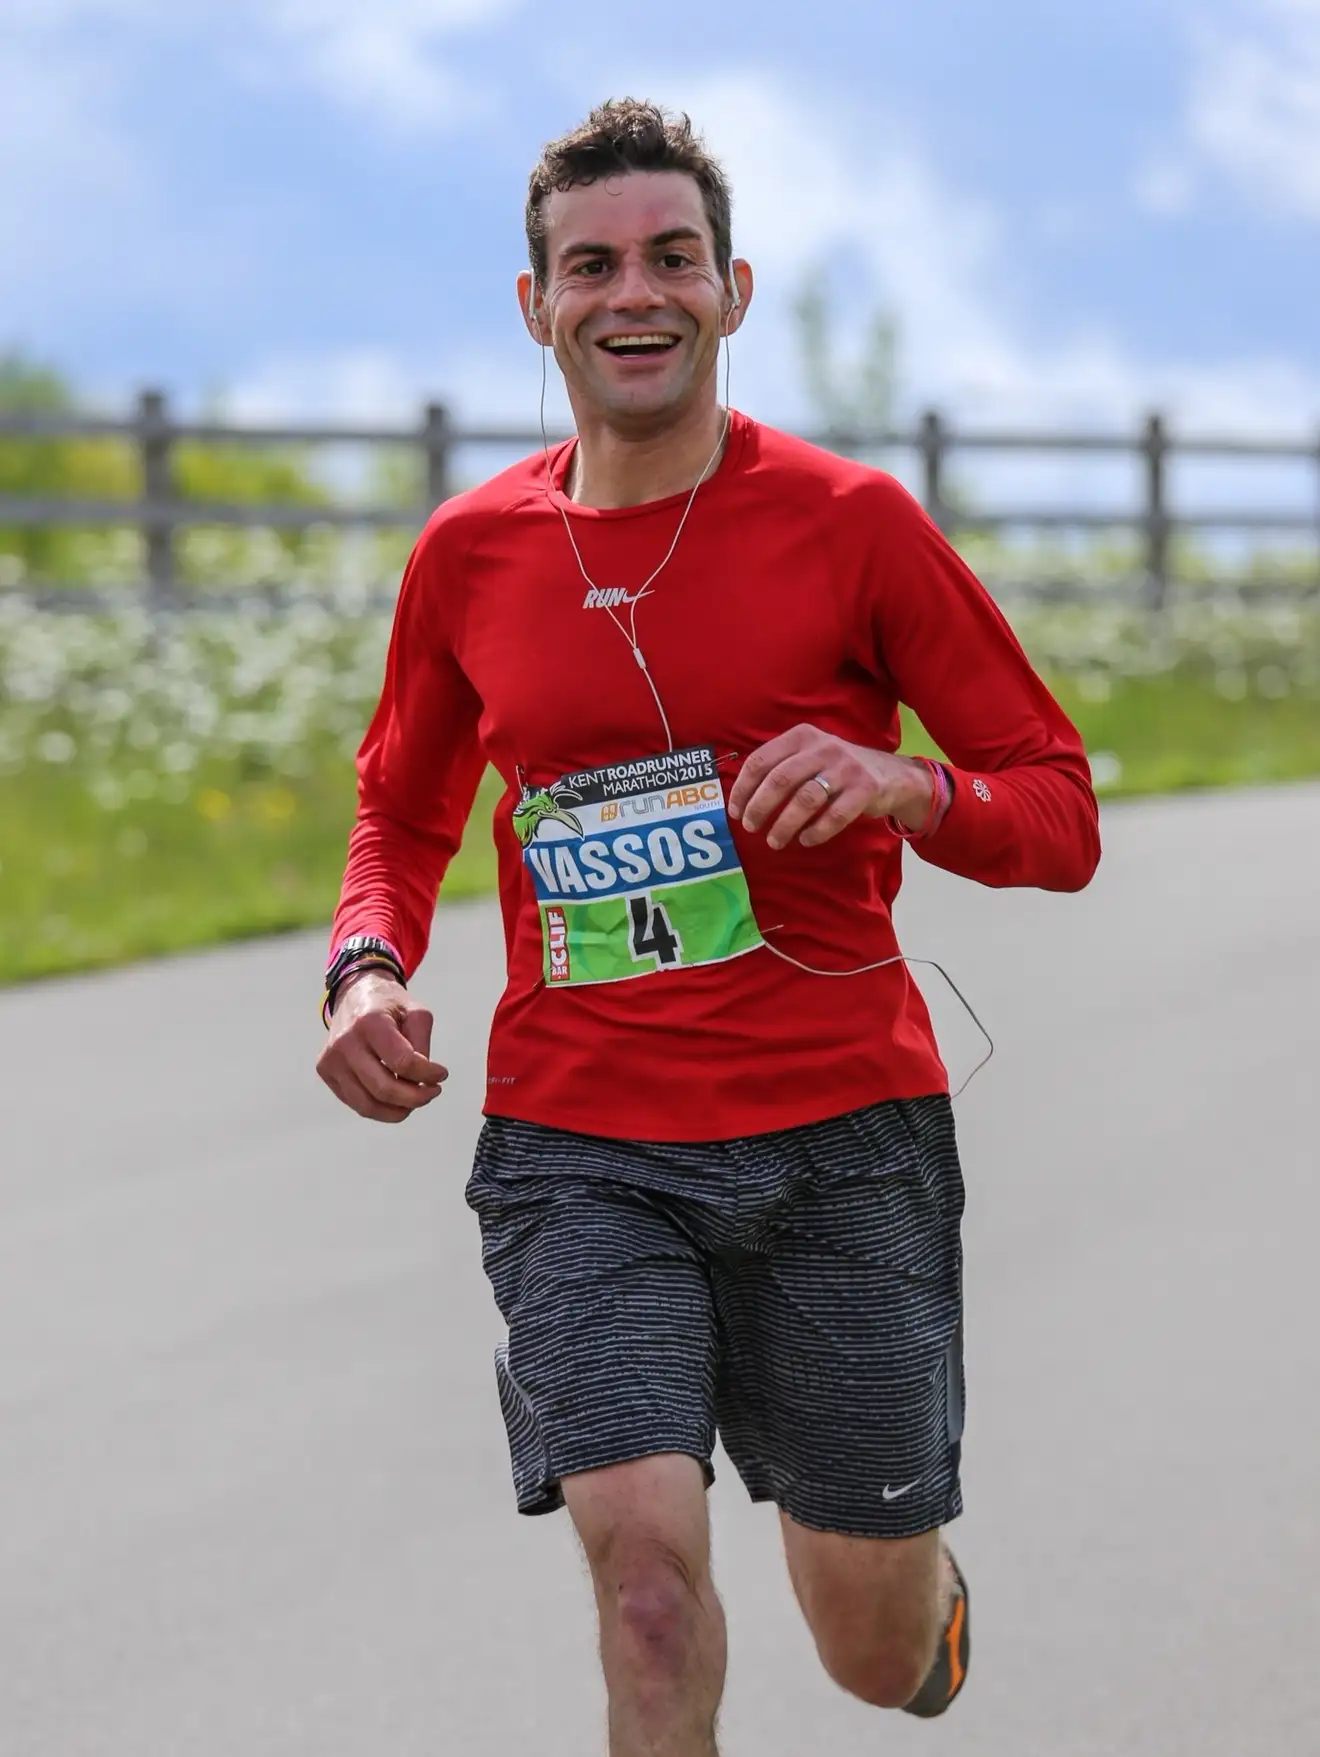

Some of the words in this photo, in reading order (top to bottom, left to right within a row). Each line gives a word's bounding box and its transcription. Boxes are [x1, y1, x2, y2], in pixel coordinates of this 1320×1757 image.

[582, 587, 626, 609] RUN
[530, 820, 723, 893] VASSOS
[549, 912, 566, 964] CLIF
[630, 897, 678, 964] 4
